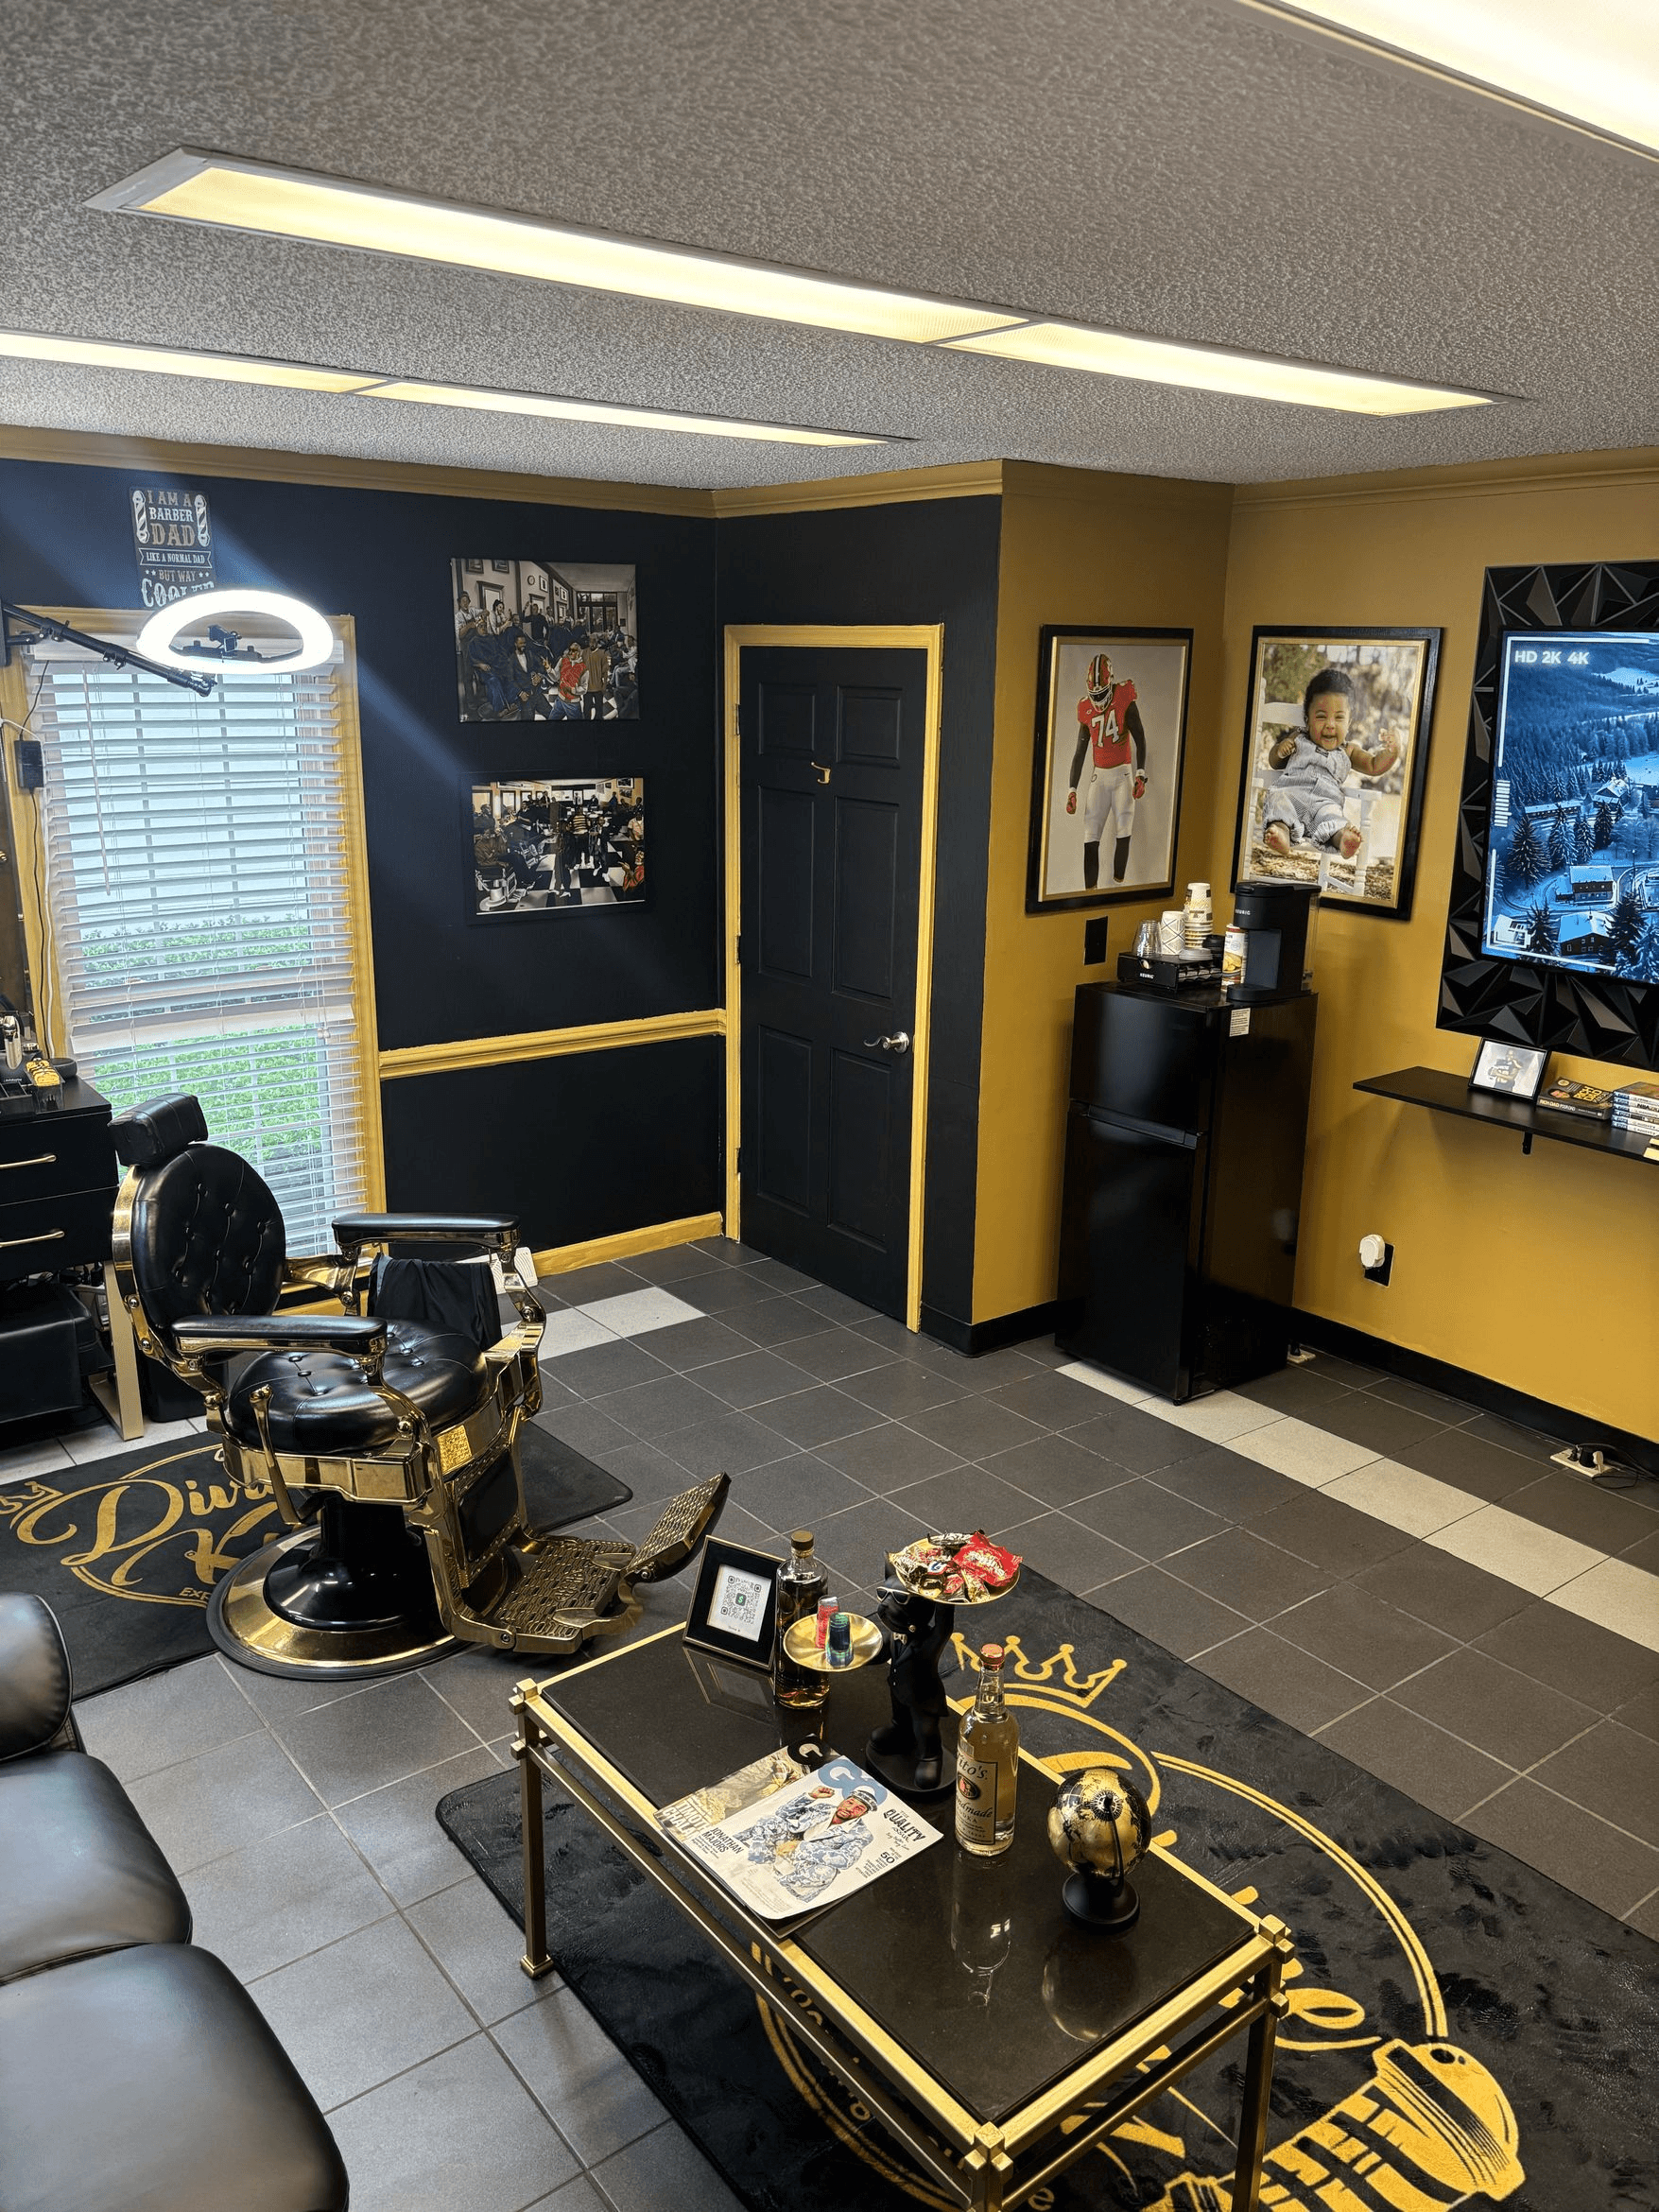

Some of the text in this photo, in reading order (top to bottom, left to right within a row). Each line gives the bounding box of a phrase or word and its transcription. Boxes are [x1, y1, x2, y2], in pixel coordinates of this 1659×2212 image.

[147, 490, 192, 508] I AM A
[148, 507, 194, 522] BARBER
[150, 523, 196, 546] DAD
[146, 552, 161, 562] LIKE
[166, 553, 192, 563] NORMAL
[193, 554, 205, 564] DAD
[159, 569, 196, 582] BUT WAY
[141, 578, 215, 607] COO
[1514, 650, 1590, 665] HD 2K 4K
[1091, 708, 1120, 748] 74
[883, 1808, 926, 1842] QUALITY
[701, 1831, 730, 1853] MAJORS
[708, 1827, 745, 1855] JONATHAN
[880, 1851, 895, 1864] 50
